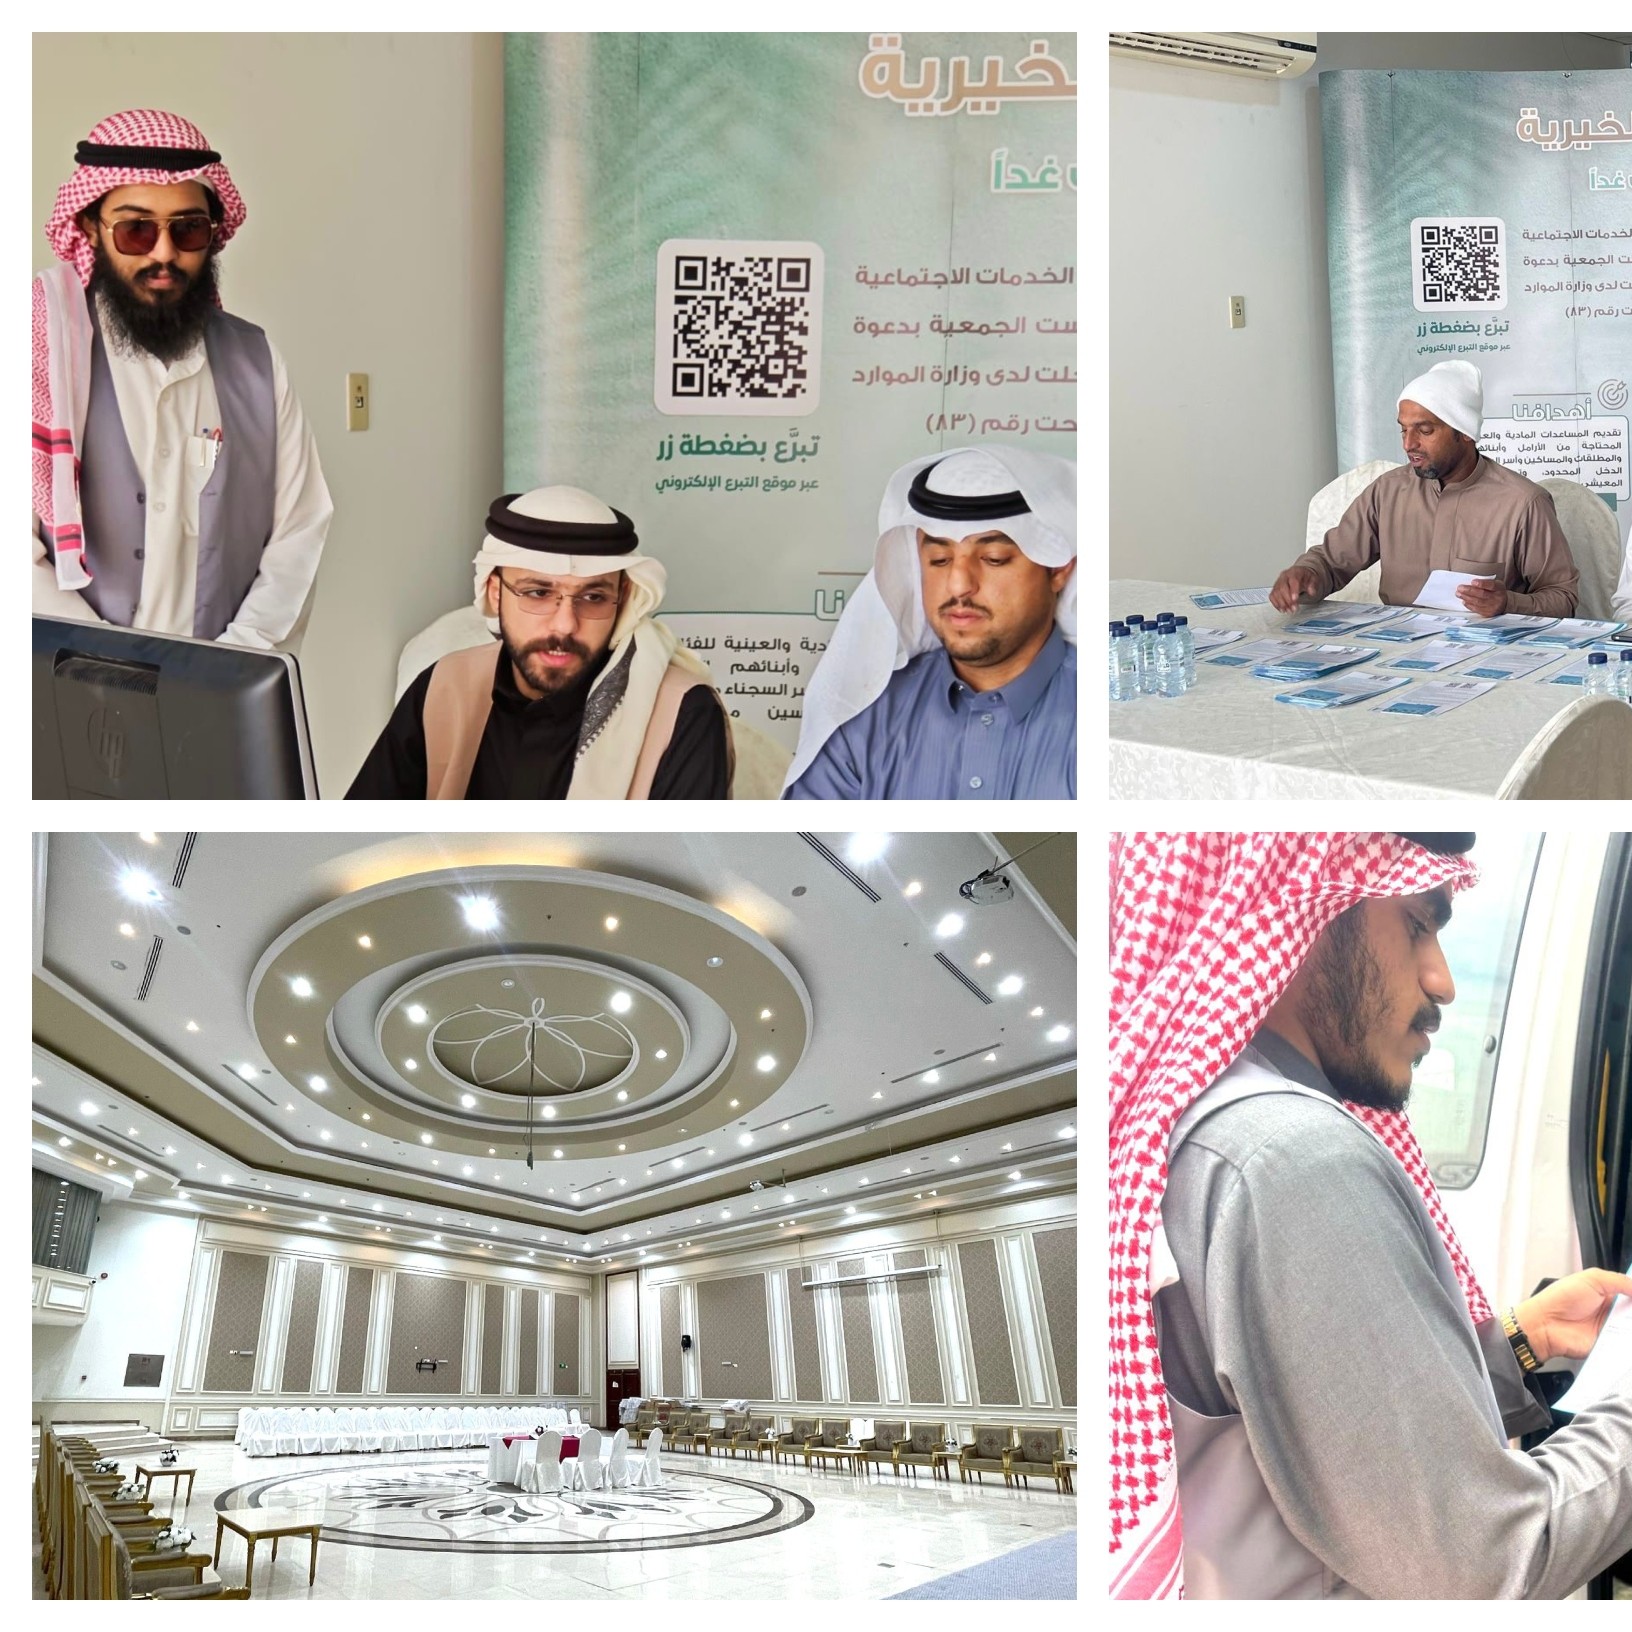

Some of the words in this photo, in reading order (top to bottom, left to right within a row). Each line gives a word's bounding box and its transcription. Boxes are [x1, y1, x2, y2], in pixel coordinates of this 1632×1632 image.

[859, 33, 1077, 116] خيرية
[1522, 229, 1583, 242] الاجتماعية
[1523, 256, 1559, 268] بدعوة
[1563, 254, 1614, 267] الجمعية
[855, 265, 970, 289] الاجتماعية
[976, 266, 1075, 286] الخدمات
[1525, 281, 1563, 293] الموارد
[1565, 281, 1593, 292] وزارة
[1595, 280, 1618, 292] لدى
[1566, 306, 1592, 318] (٨٣)
[1594, 306, 1619, 317] رقم
[853, 316, 921, 338] بدعوة
[929, 314, 1026, 338] الجمعية
[1036, 317, 1077, 334] ست
[1417, 322, 1427, 337] زر
[1430, 320, 1480, 336] بضغطة
[1417, 343, 1456, 355] الإلكتروني
[1458, 343, 1477, 353] التبرع
[1479, 342, 1498, 353] موقع
[1499, 343, 1511, 352] عبر
[852, 365, 926, 386] الموارد
[930, 365, 981, 386] وزارة
[986, 365, 1031, 386] لدى
[1512, 396, 1592, 421] أهدافنا
[926, 412, 976, 435] (٨٣)
[981, 414, 1030, 435] رقم
[1035, 416, 1077, 433] حت
[1480, 432, 1501, 440] والع
[1505, 430, 1536, 439] المادية
[1541, 430, 1589, 439] المساعدات
[1593, 429, 1621, 439] تقديم
[656, 434, 674, 461] زر
[679, 433, 767, 462] بضغطة
[1477, 444, 1507, 453] وأبنائه
[1518, 443, 1546, 453] الأرامل
[1557, 442, 1571, 451] من
[1581, 442, 1622, 451] المحتاجة
[1502, 456, 1523, 465] وأسر
[1524, 456, 1573, 465] والمساكين
[1574, 455, 1622, 463] والمطلقات
[1596, 467, 1622, 476] الدخل
[655, 475, 722, 493] الإلكتروني
[725, 475, 759, 492] التبرع
[762, 476, 797, 492] موقع
[799, 478, 819, 492] عبر
[680, 636, 716, 650] للفئ
[724, 635, 791, 653] والعينية
[800, 636, 829, 654] دية
[730, 659, 800, 676] وأبنائهم
[724, 682, 788, 698] السجناء
[768, 706, 804, 721] سين
